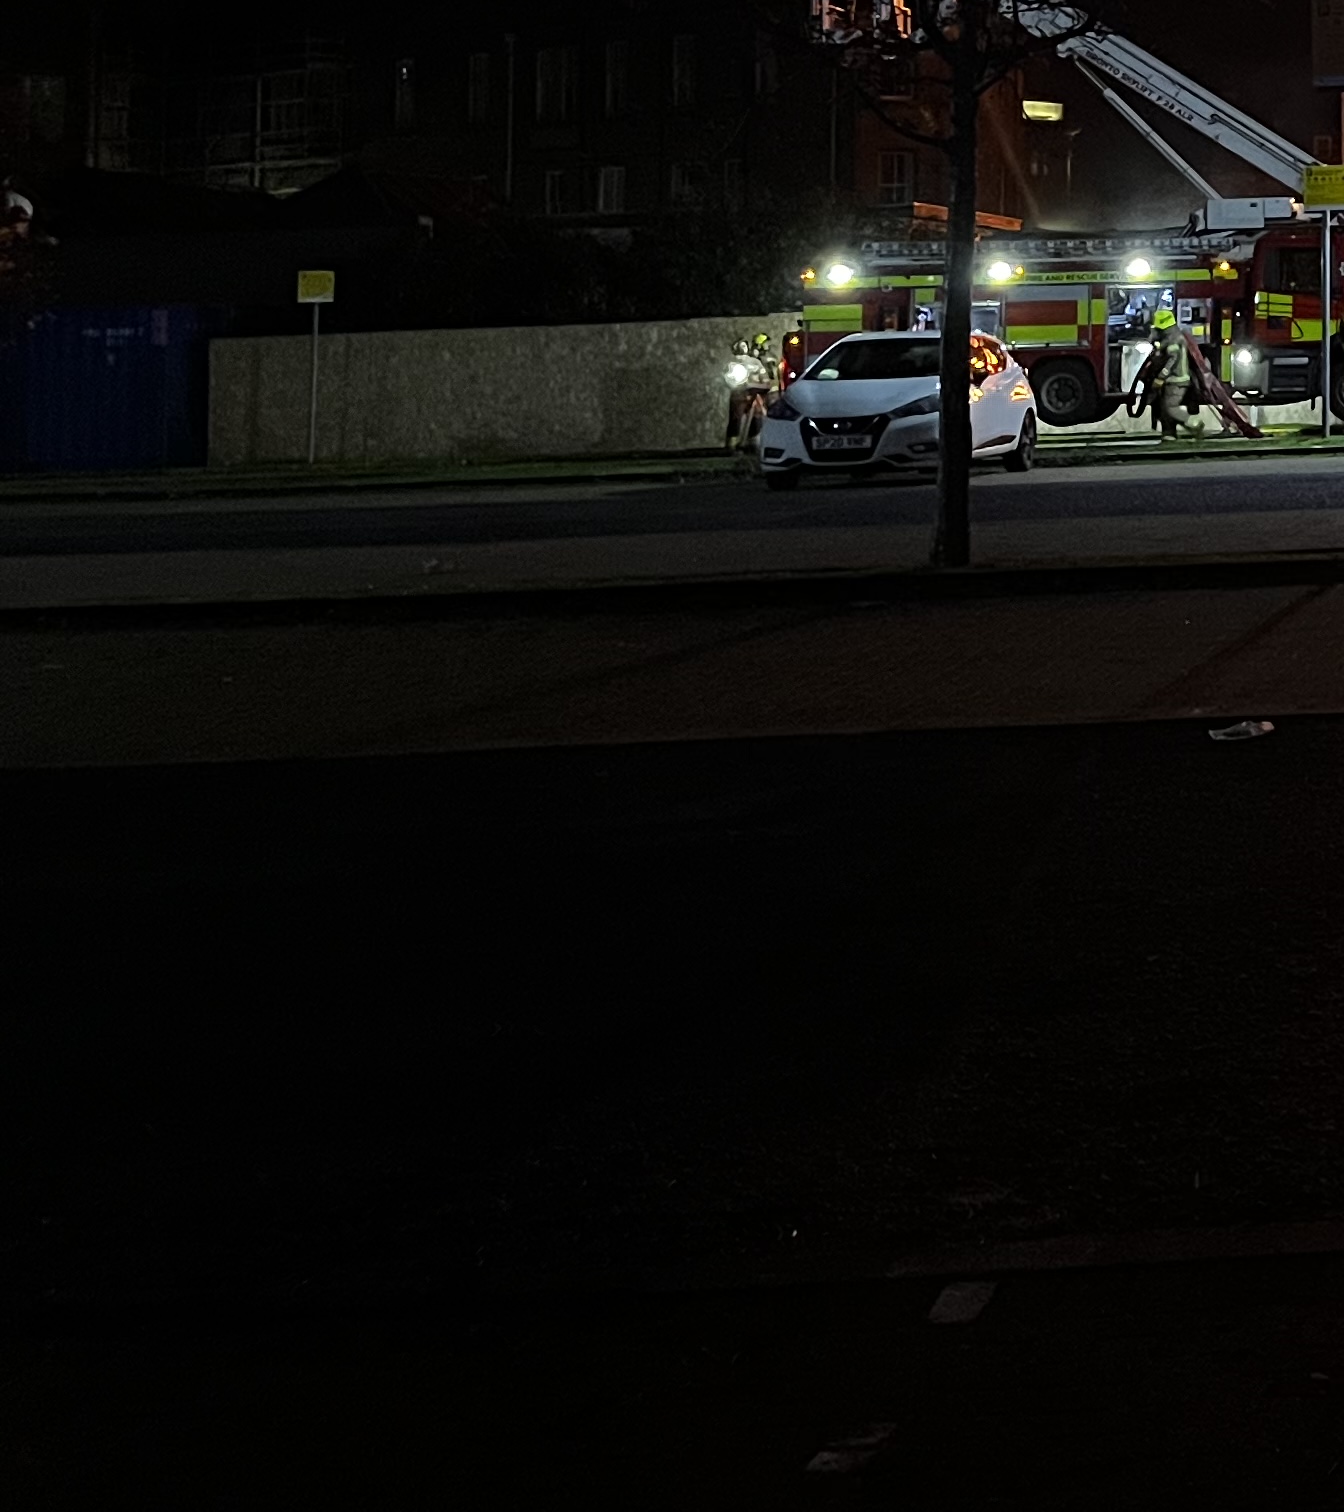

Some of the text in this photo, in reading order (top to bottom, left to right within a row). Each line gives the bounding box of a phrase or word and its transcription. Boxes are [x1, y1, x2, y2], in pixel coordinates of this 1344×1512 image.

[1085, 50, 1120, 76] BRONTO
[1121, 73, 1156, 97] SKYLIFT
[1066, 273, 1098, 281] RESCUE
